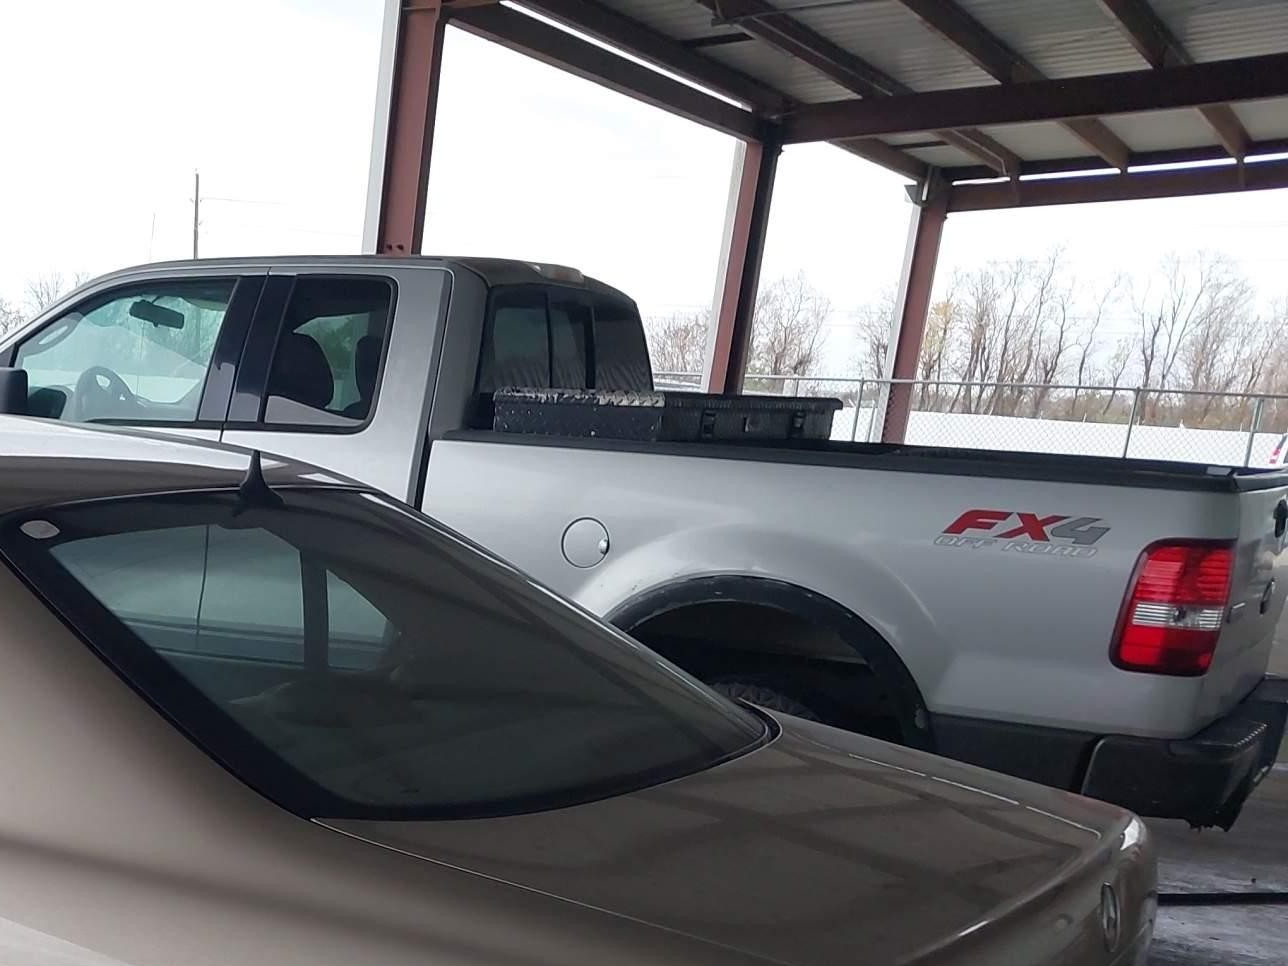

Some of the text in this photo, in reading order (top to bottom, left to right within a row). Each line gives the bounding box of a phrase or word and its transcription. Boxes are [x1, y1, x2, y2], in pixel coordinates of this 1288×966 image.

[942, 509, 1111, 546] FX4
[933, 535, 1099, 559] OFF ROAD
